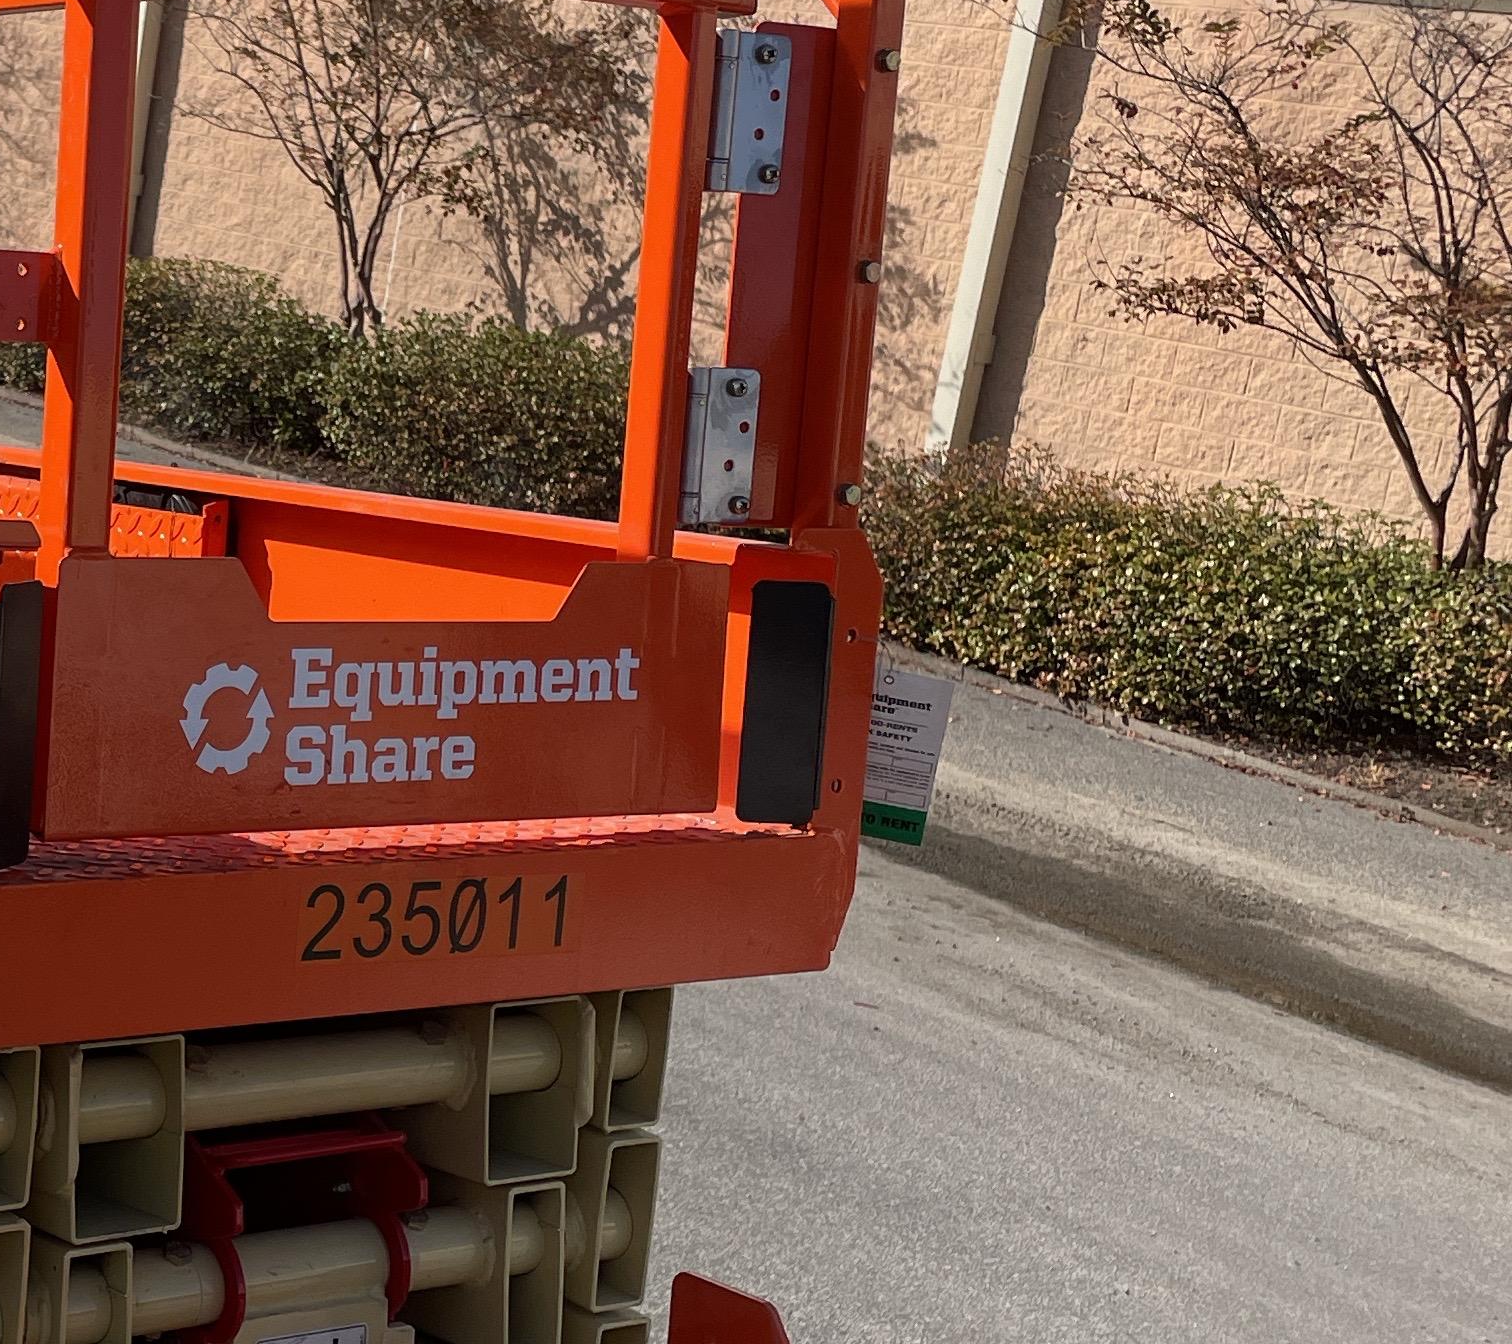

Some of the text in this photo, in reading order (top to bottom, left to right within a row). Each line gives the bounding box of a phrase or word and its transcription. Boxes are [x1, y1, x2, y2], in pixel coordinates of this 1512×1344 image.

[289, 646, 641, 722] Equipment
[283, 724, 477, 786] Share
[880, 814, 921, 834] RENT
